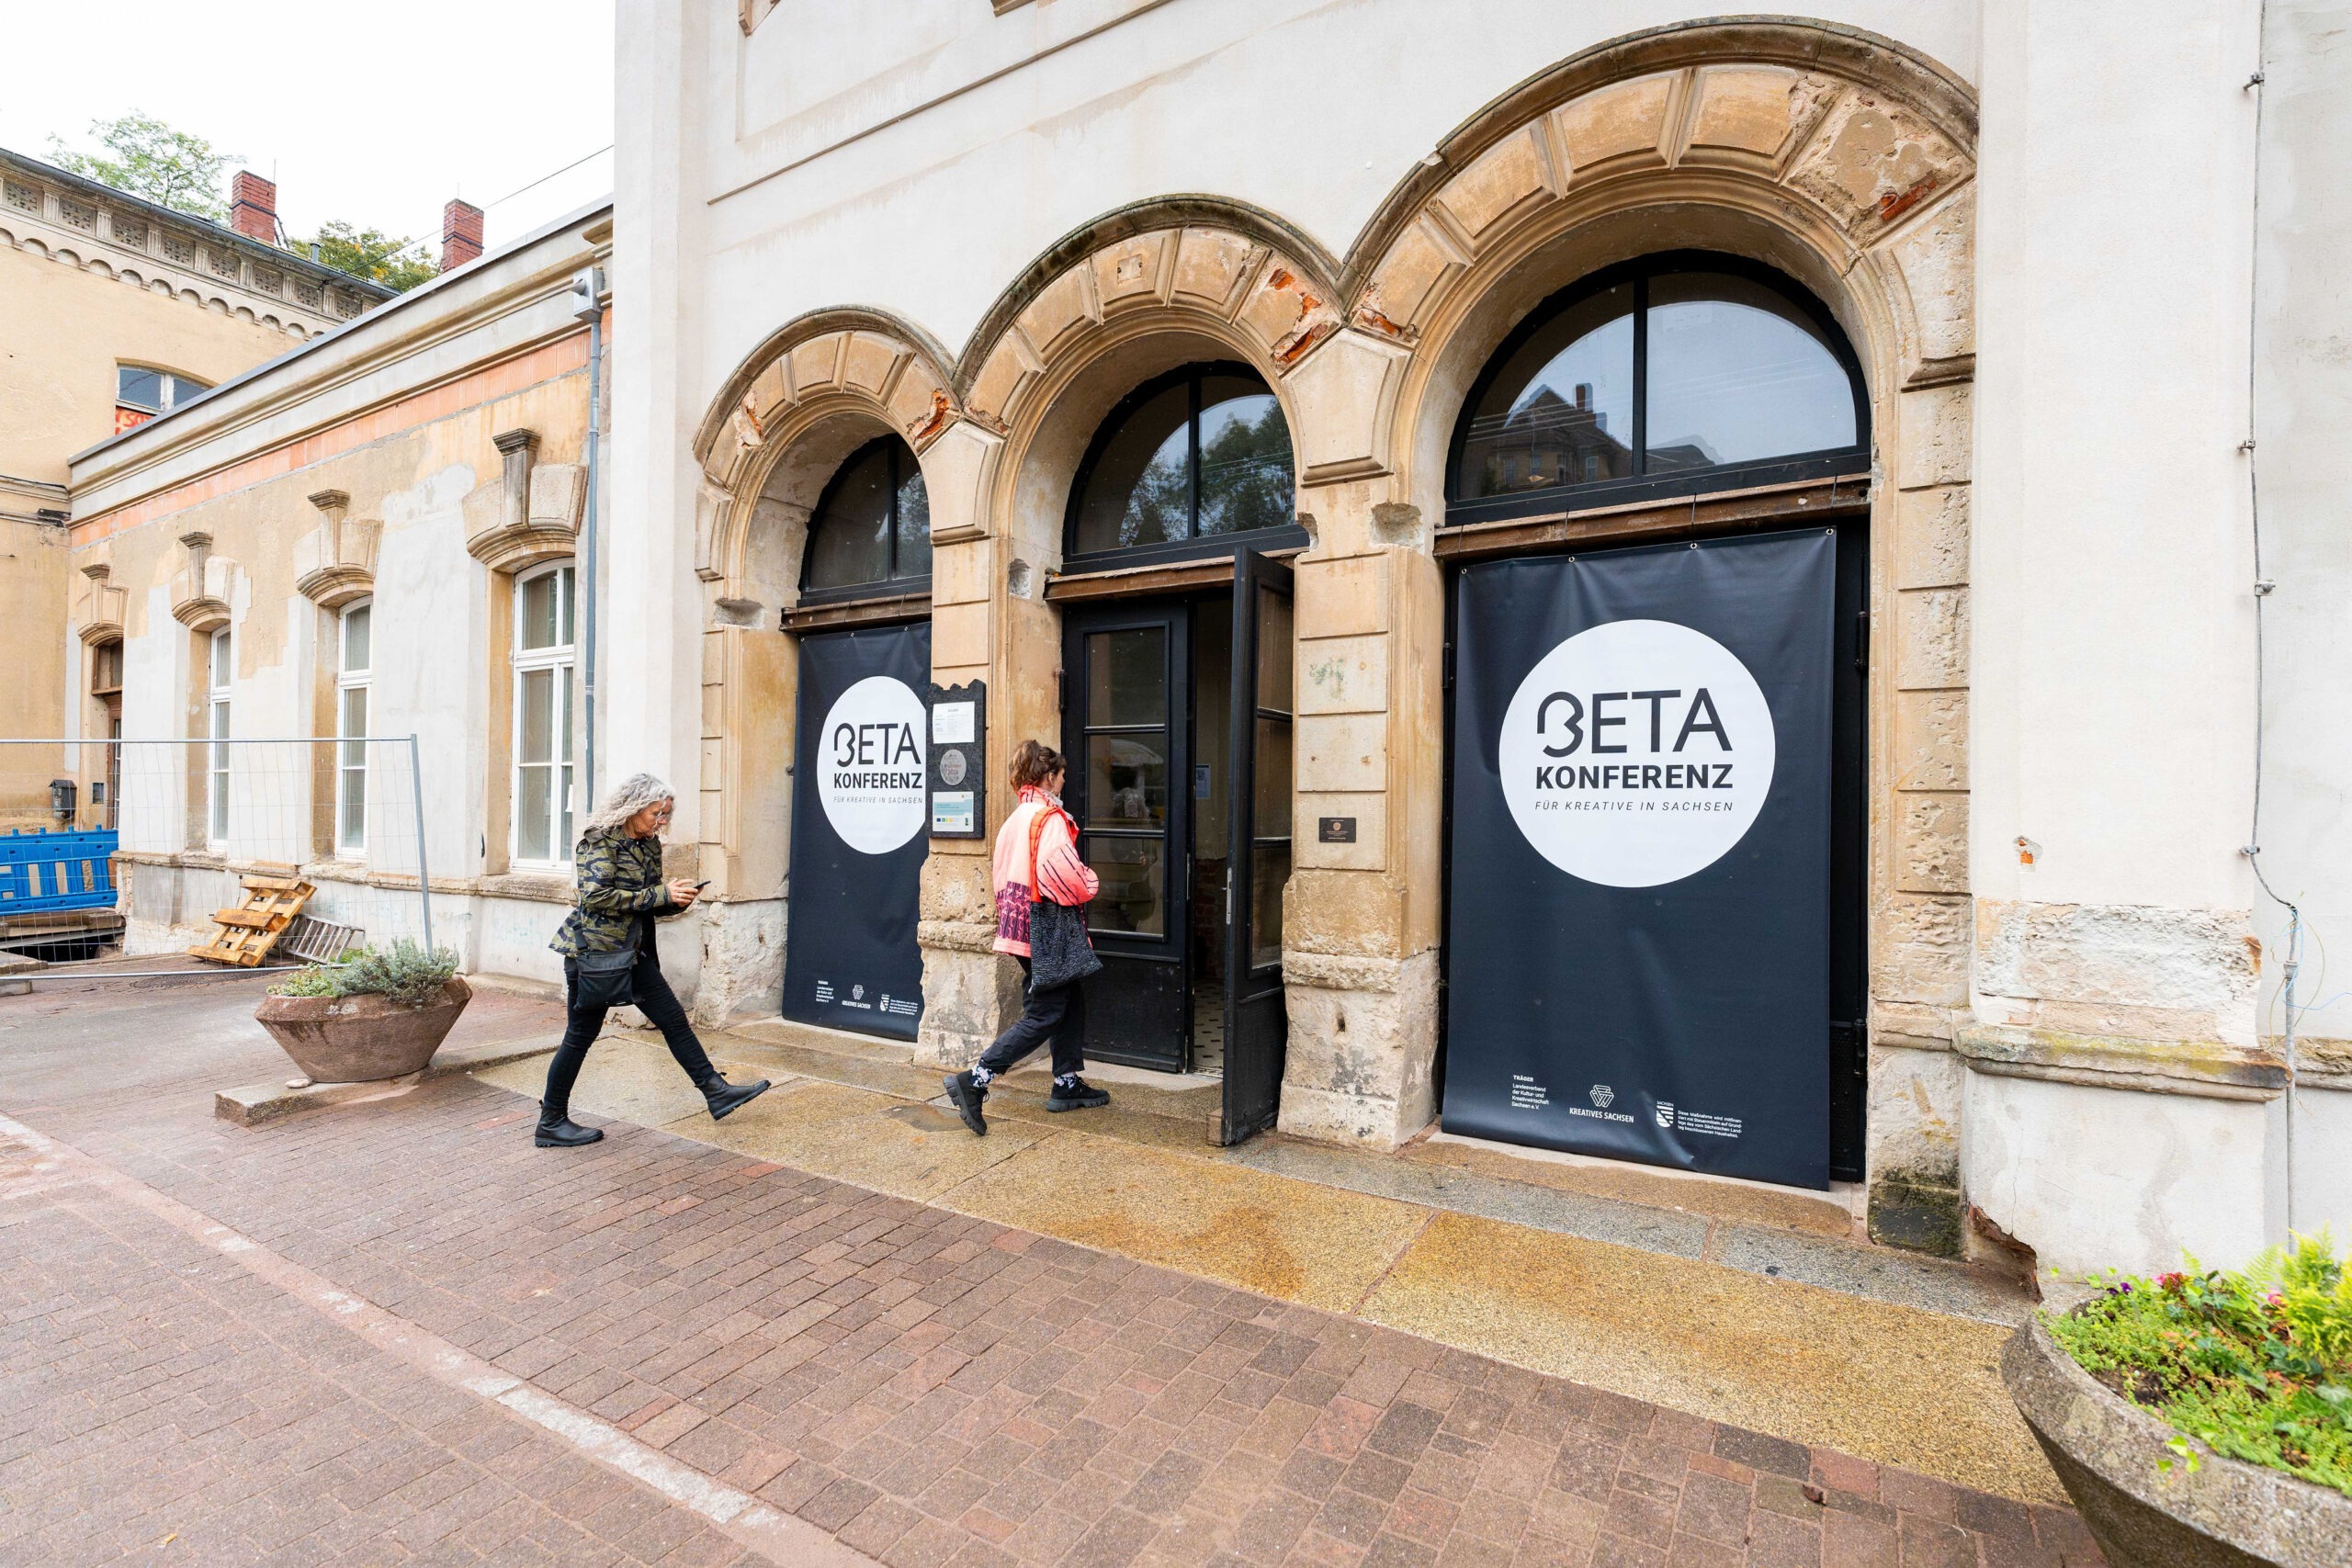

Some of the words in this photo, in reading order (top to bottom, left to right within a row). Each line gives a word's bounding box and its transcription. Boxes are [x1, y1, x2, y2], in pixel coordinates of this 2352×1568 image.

[1537, 688, 1733, 758] BETA
[834, 722, 922, 768] BETA
[834, 773, 922, 789] KONFERENZ
[1536, 763, 1734, 789] KONFERENZ
[888, 796, 922, 805] SACHSEN
[1535, 800, 1559, 810] FÜR
[1565, 801, 1634, 811] KREATIVE
[1640, 801, 1655, 811] IN
[1662, 801, 1734, 812] SACHSEN
[1569, 1107, 1603, 1119] KREATIVES
[1603, 1111, 1634, 1123] SACHSEN
